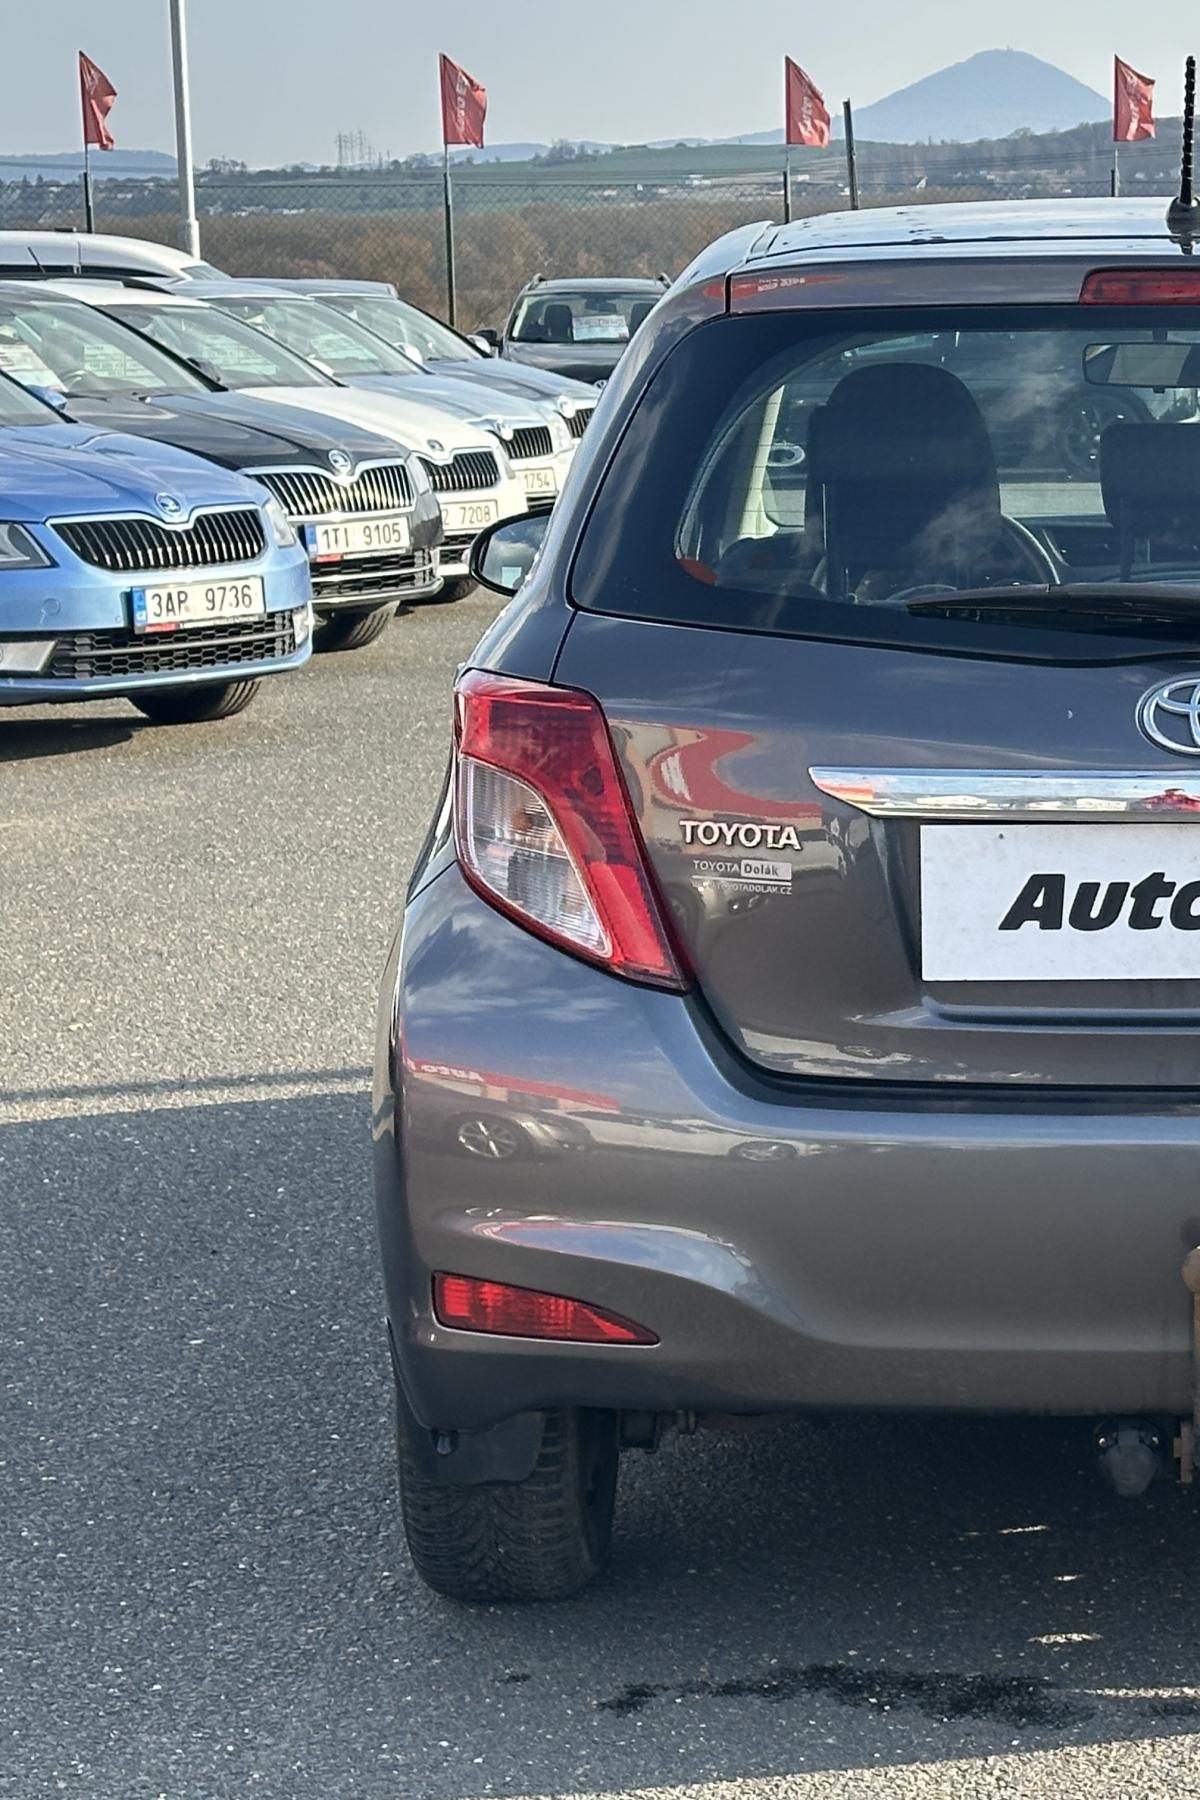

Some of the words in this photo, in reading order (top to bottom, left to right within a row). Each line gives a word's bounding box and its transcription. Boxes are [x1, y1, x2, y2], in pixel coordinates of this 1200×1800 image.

[524, 472, 550, 490] 1754
[459, 505, 492, 525] 7208
[362, 522, 401, 546] 9105
[151, 591, 188, 618] 3AP
[205, 584, 252, 612] 9736
[679, 820, 802, 851] TOYOTA
[693, 860, 740, 874] TOYOTA
[743, 863, 779, 877] Dolák
